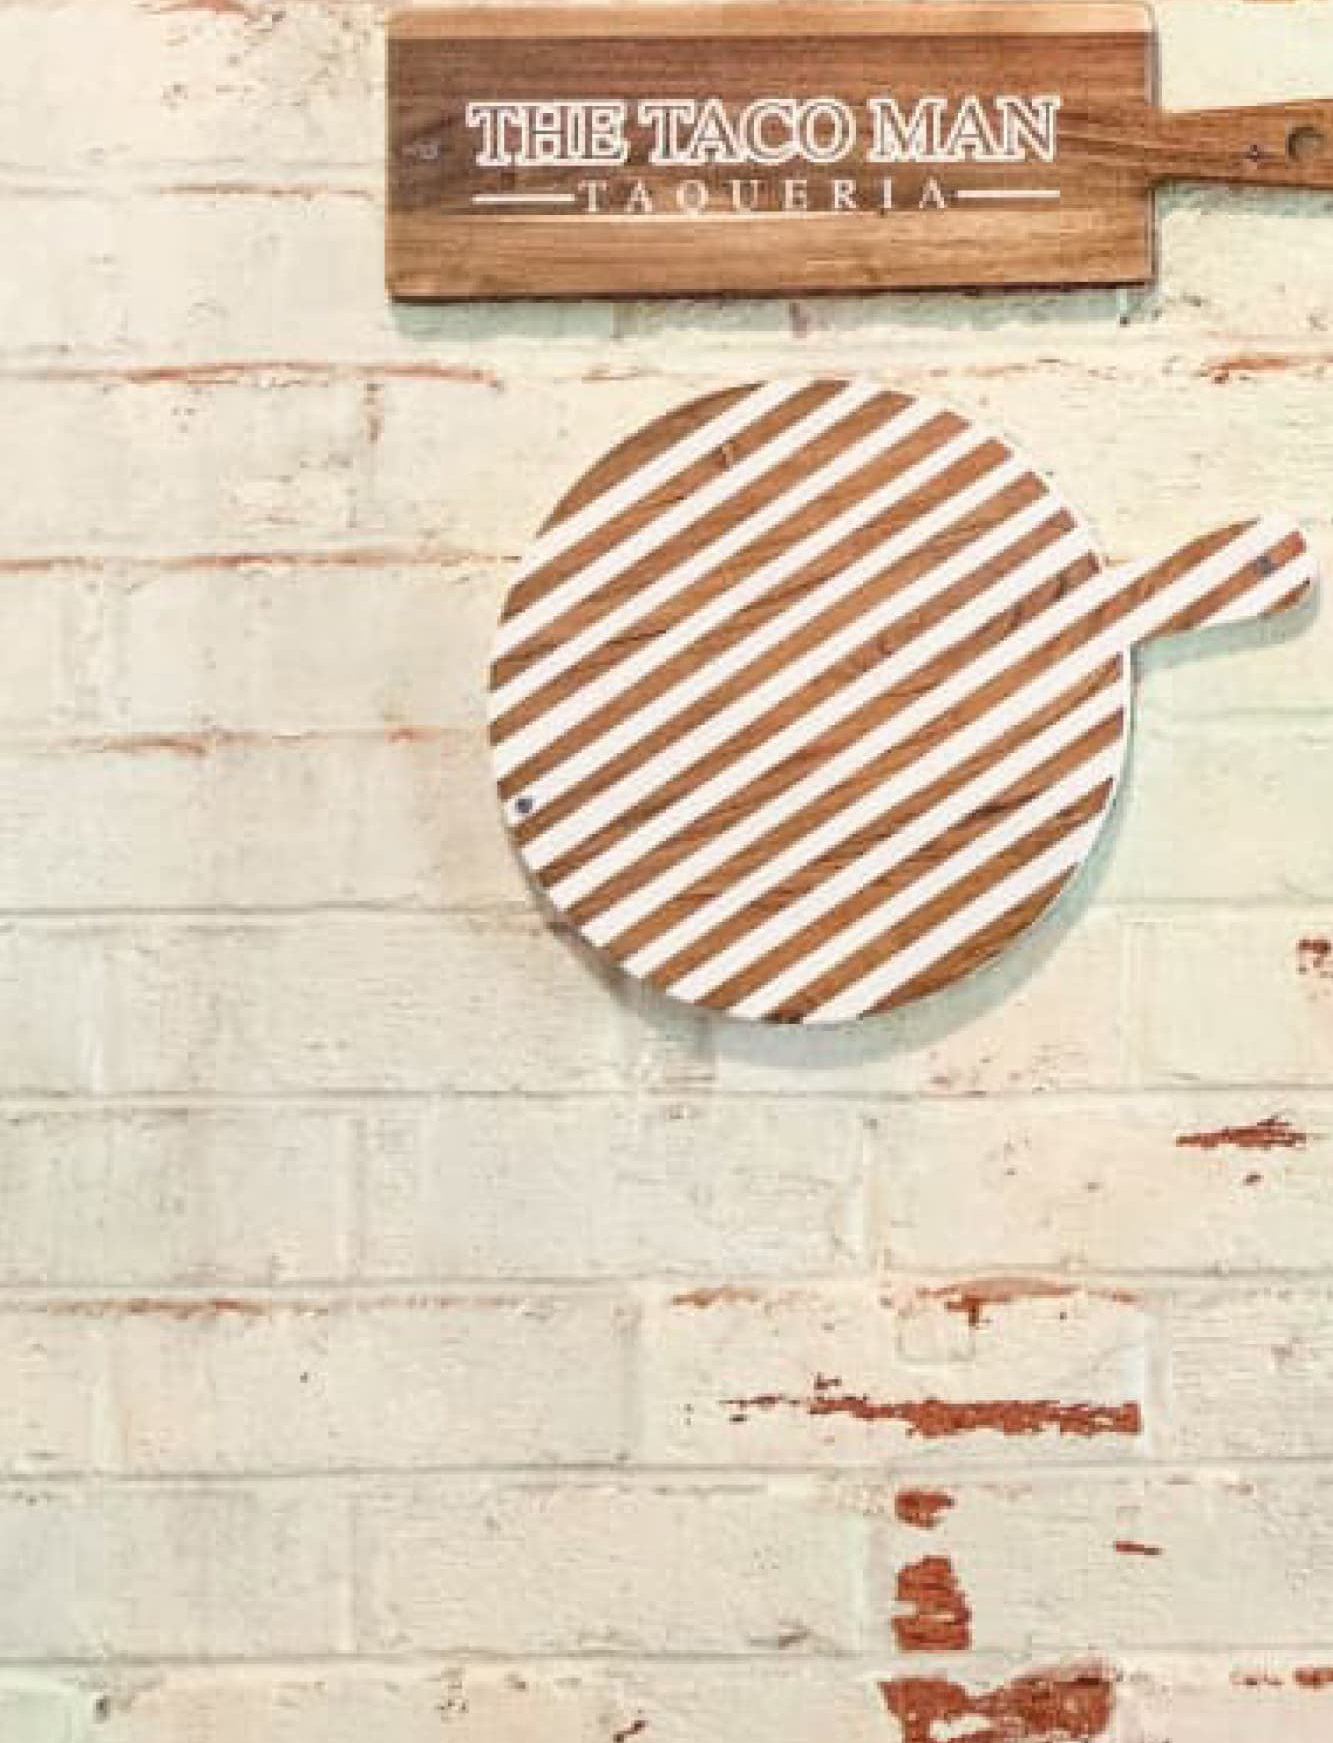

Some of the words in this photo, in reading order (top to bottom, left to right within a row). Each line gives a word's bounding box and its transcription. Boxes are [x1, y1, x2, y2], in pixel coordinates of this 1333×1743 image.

[466, 101, 628, 166] THE
[637, 98, 858, 166] TACO
[866, 95, 1062, 163] MAN
[577, 177, 946, 213] TAQUERIA
